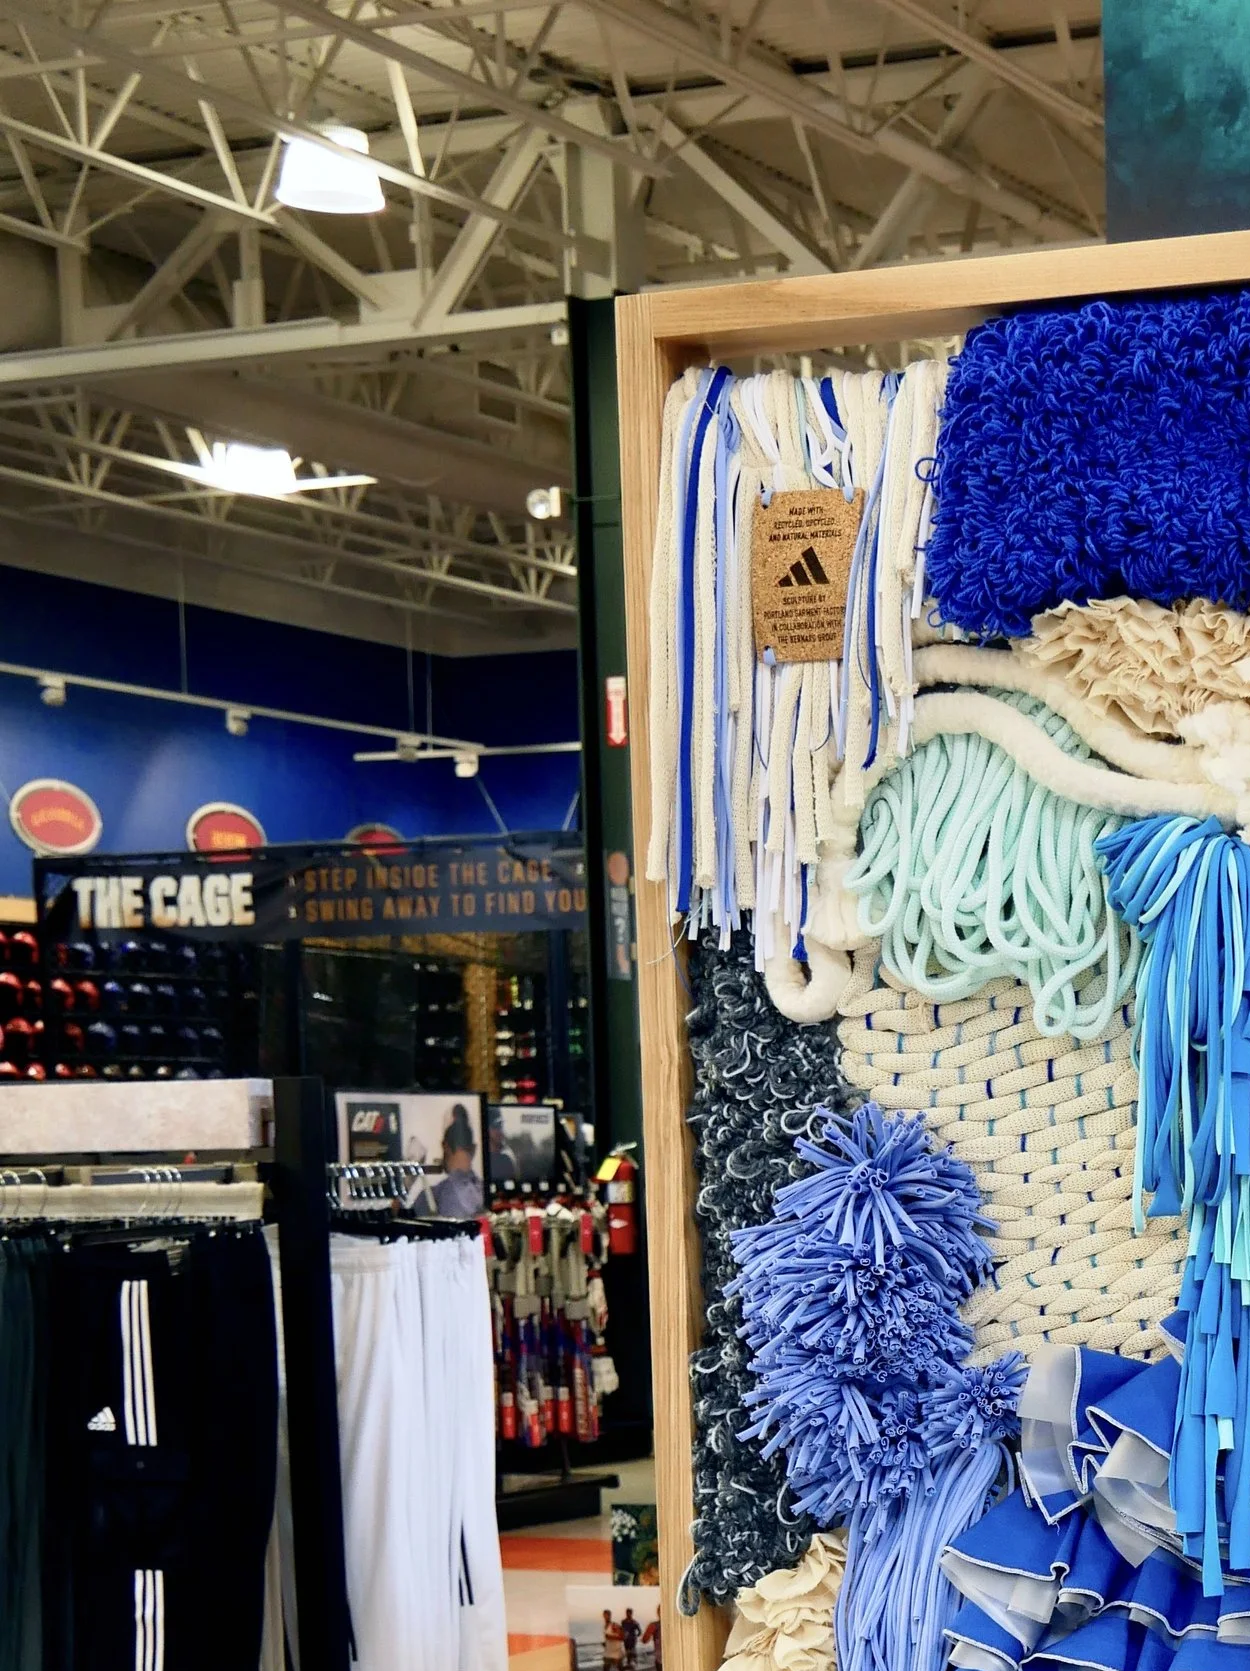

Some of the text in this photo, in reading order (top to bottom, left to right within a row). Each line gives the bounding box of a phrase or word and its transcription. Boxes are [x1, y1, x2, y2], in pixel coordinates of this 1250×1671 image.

[789, 506, 806, 516] MADE
[769, 529, 841, 542] AND NATURAL MATERIALS
[783, 595, 816, 605] SCULPTURE
[764, 609, 794, 620] PORTLAND
[823, 605, 846, 616] FACTOR
[304, 867, 357, 893] STEP
[366, 863, 439, 890] INSIDE
[449, 861, 489, 886] THE
[497, 859, 553, 884] CAGE
[72, 872, 256, 930] THE CAGE
[304, 897, 374, 923] SWING
[382, 896, 441, 920] AWAY
[451, 892, 476, 917] TO
[484, 890, 536, 916] FIND
